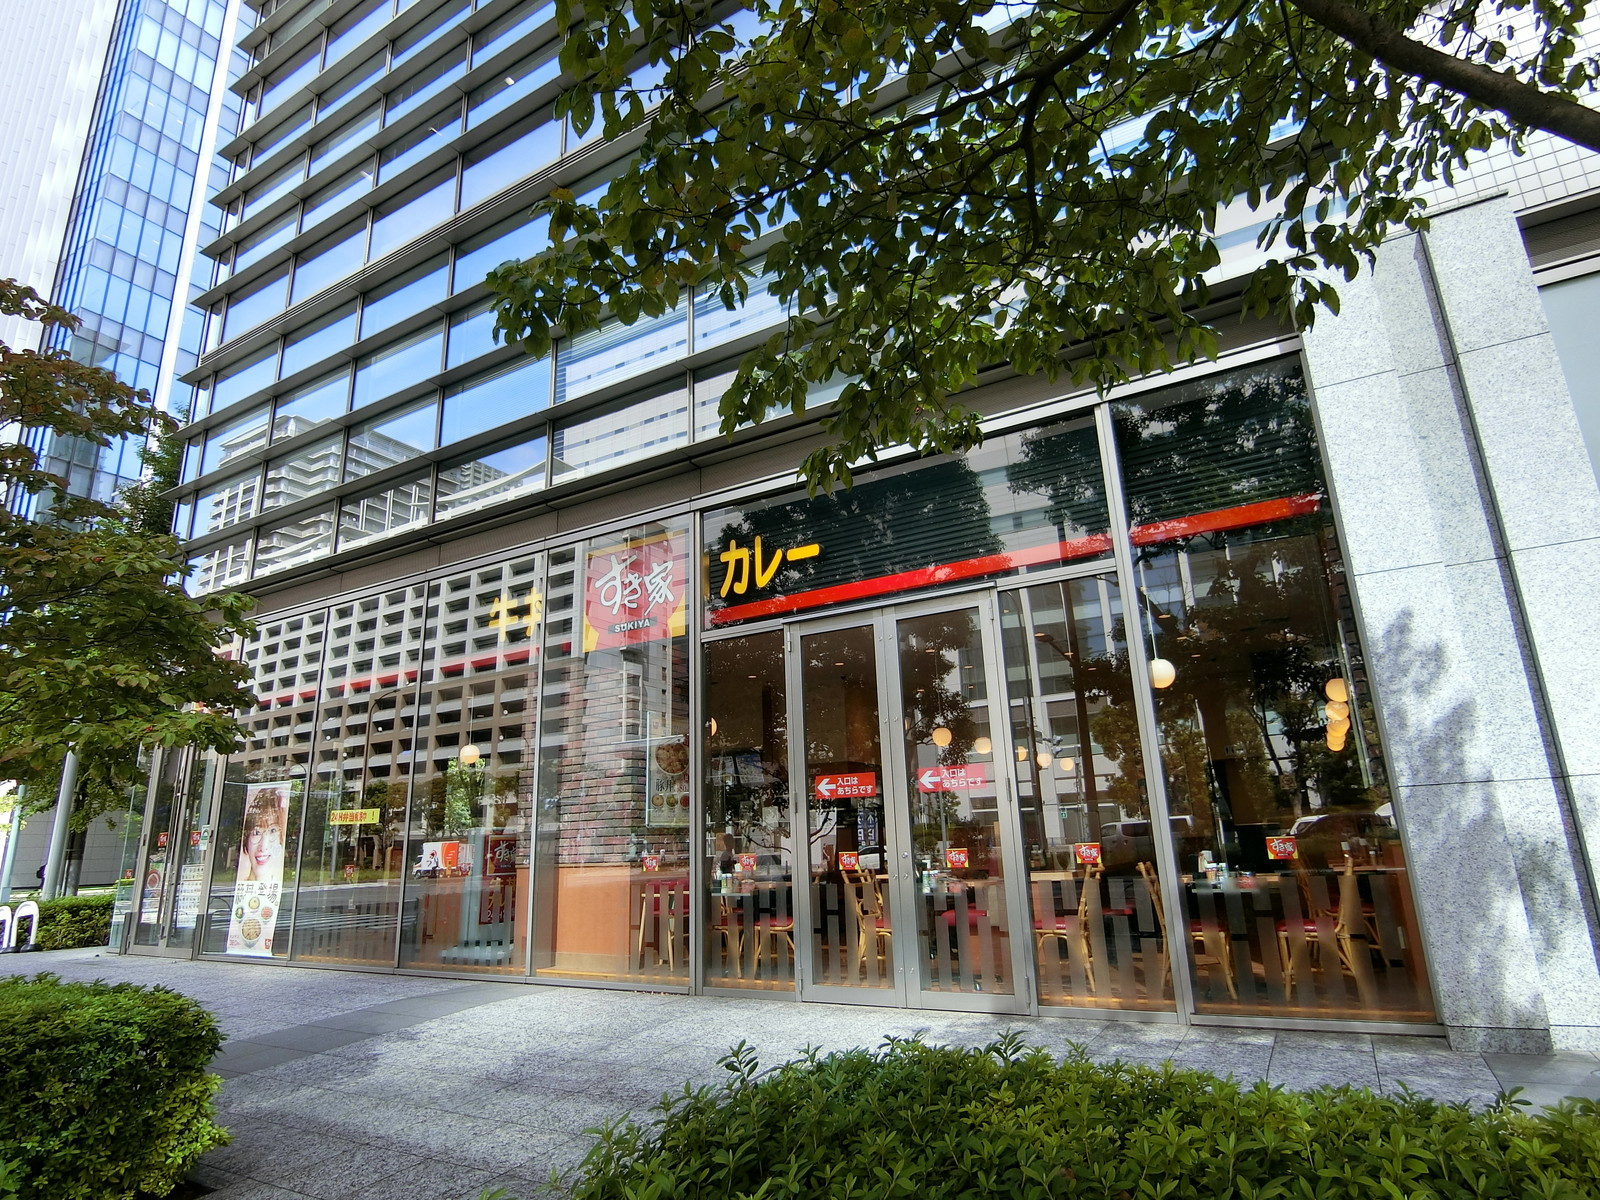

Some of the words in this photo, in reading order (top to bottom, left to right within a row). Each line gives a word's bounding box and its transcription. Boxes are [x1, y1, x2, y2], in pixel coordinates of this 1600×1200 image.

[719, 535, 820, 599] カレー
[595, 554, 674, 616] すき家
[614, 618, 651, 633] SUKIYA
[941, 768, 966, 778] 入口は
[836, 777, 859, 786] 入口は
[942, 777, 983, 788] あちらです
[837, 785, 873, 795] あちらです
